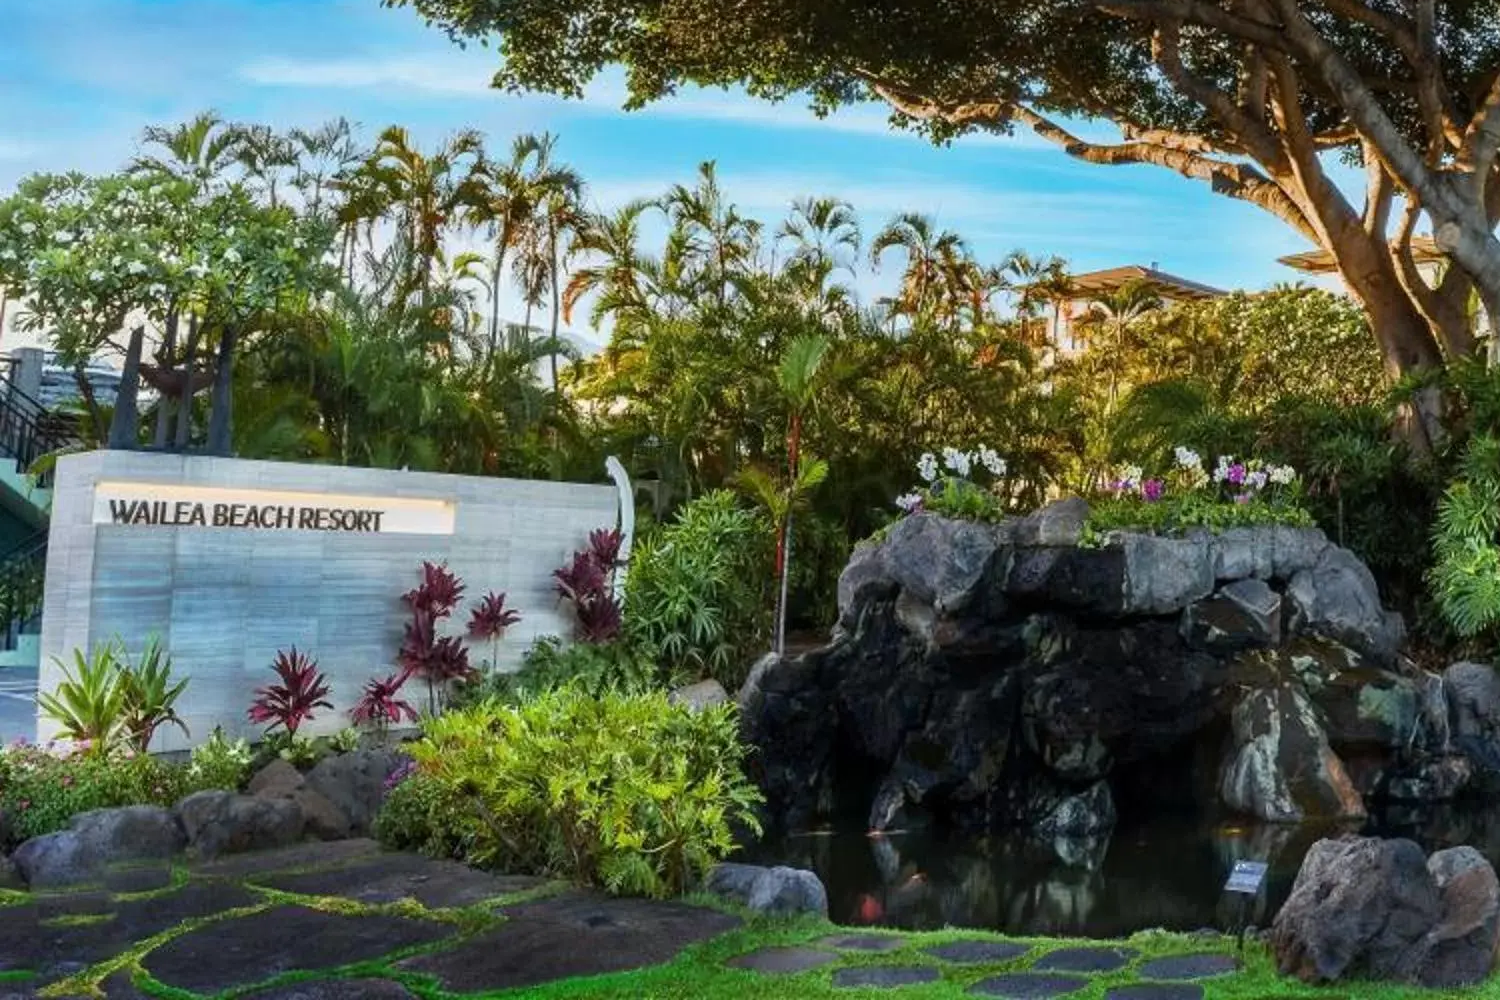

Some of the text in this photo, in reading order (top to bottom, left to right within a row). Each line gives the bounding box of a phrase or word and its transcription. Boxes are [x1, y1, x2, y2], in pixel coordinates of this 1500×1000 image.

[109, 500, 385, 532] WAILEA BEACH RESORT
